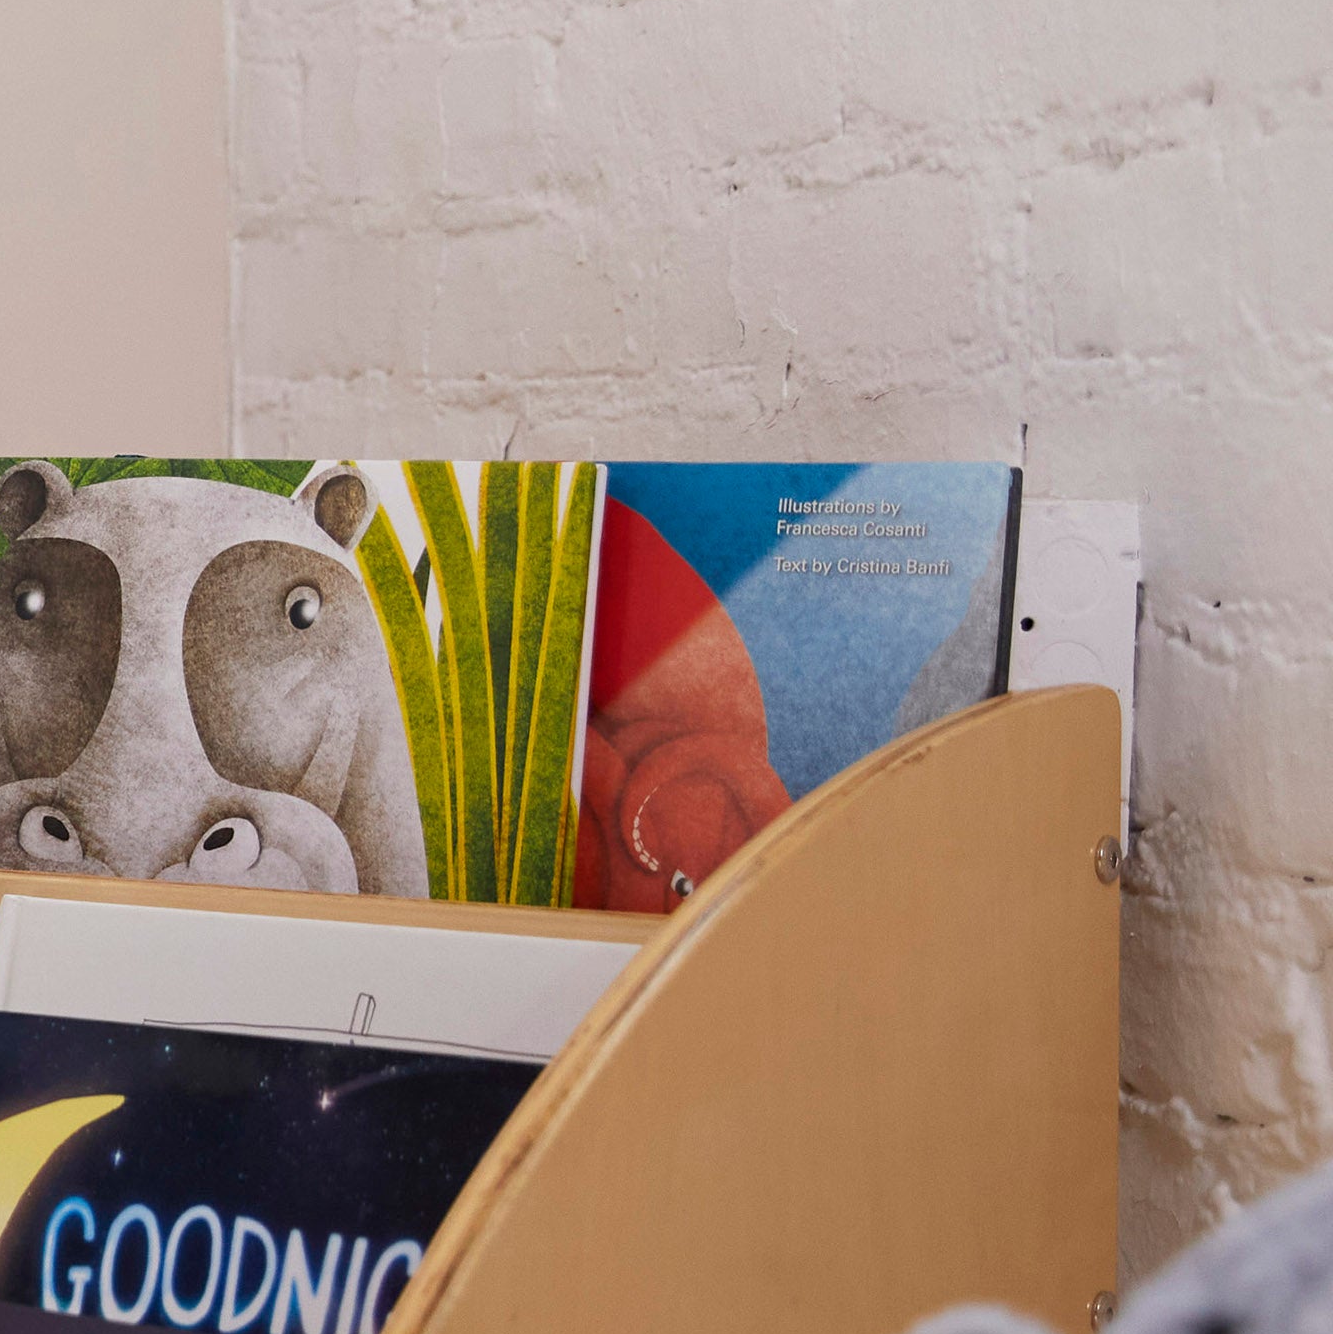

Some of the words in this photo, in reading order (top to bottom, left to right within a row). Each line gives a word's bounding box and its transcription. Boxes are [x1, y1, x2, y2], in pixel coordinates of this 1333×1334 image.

[778, 498, 875, 514] Illustrations
[880, 499, 901, 517] by
[776, 520, 858, 536] Francesca
[863, 521, 927, 537] Cosanti
[774, 556, 807, 572] Text
[812, 558, 832, 576] by
[837, 558, 900, 574] Cristina
[906, 559, 950, 575] Banfi
